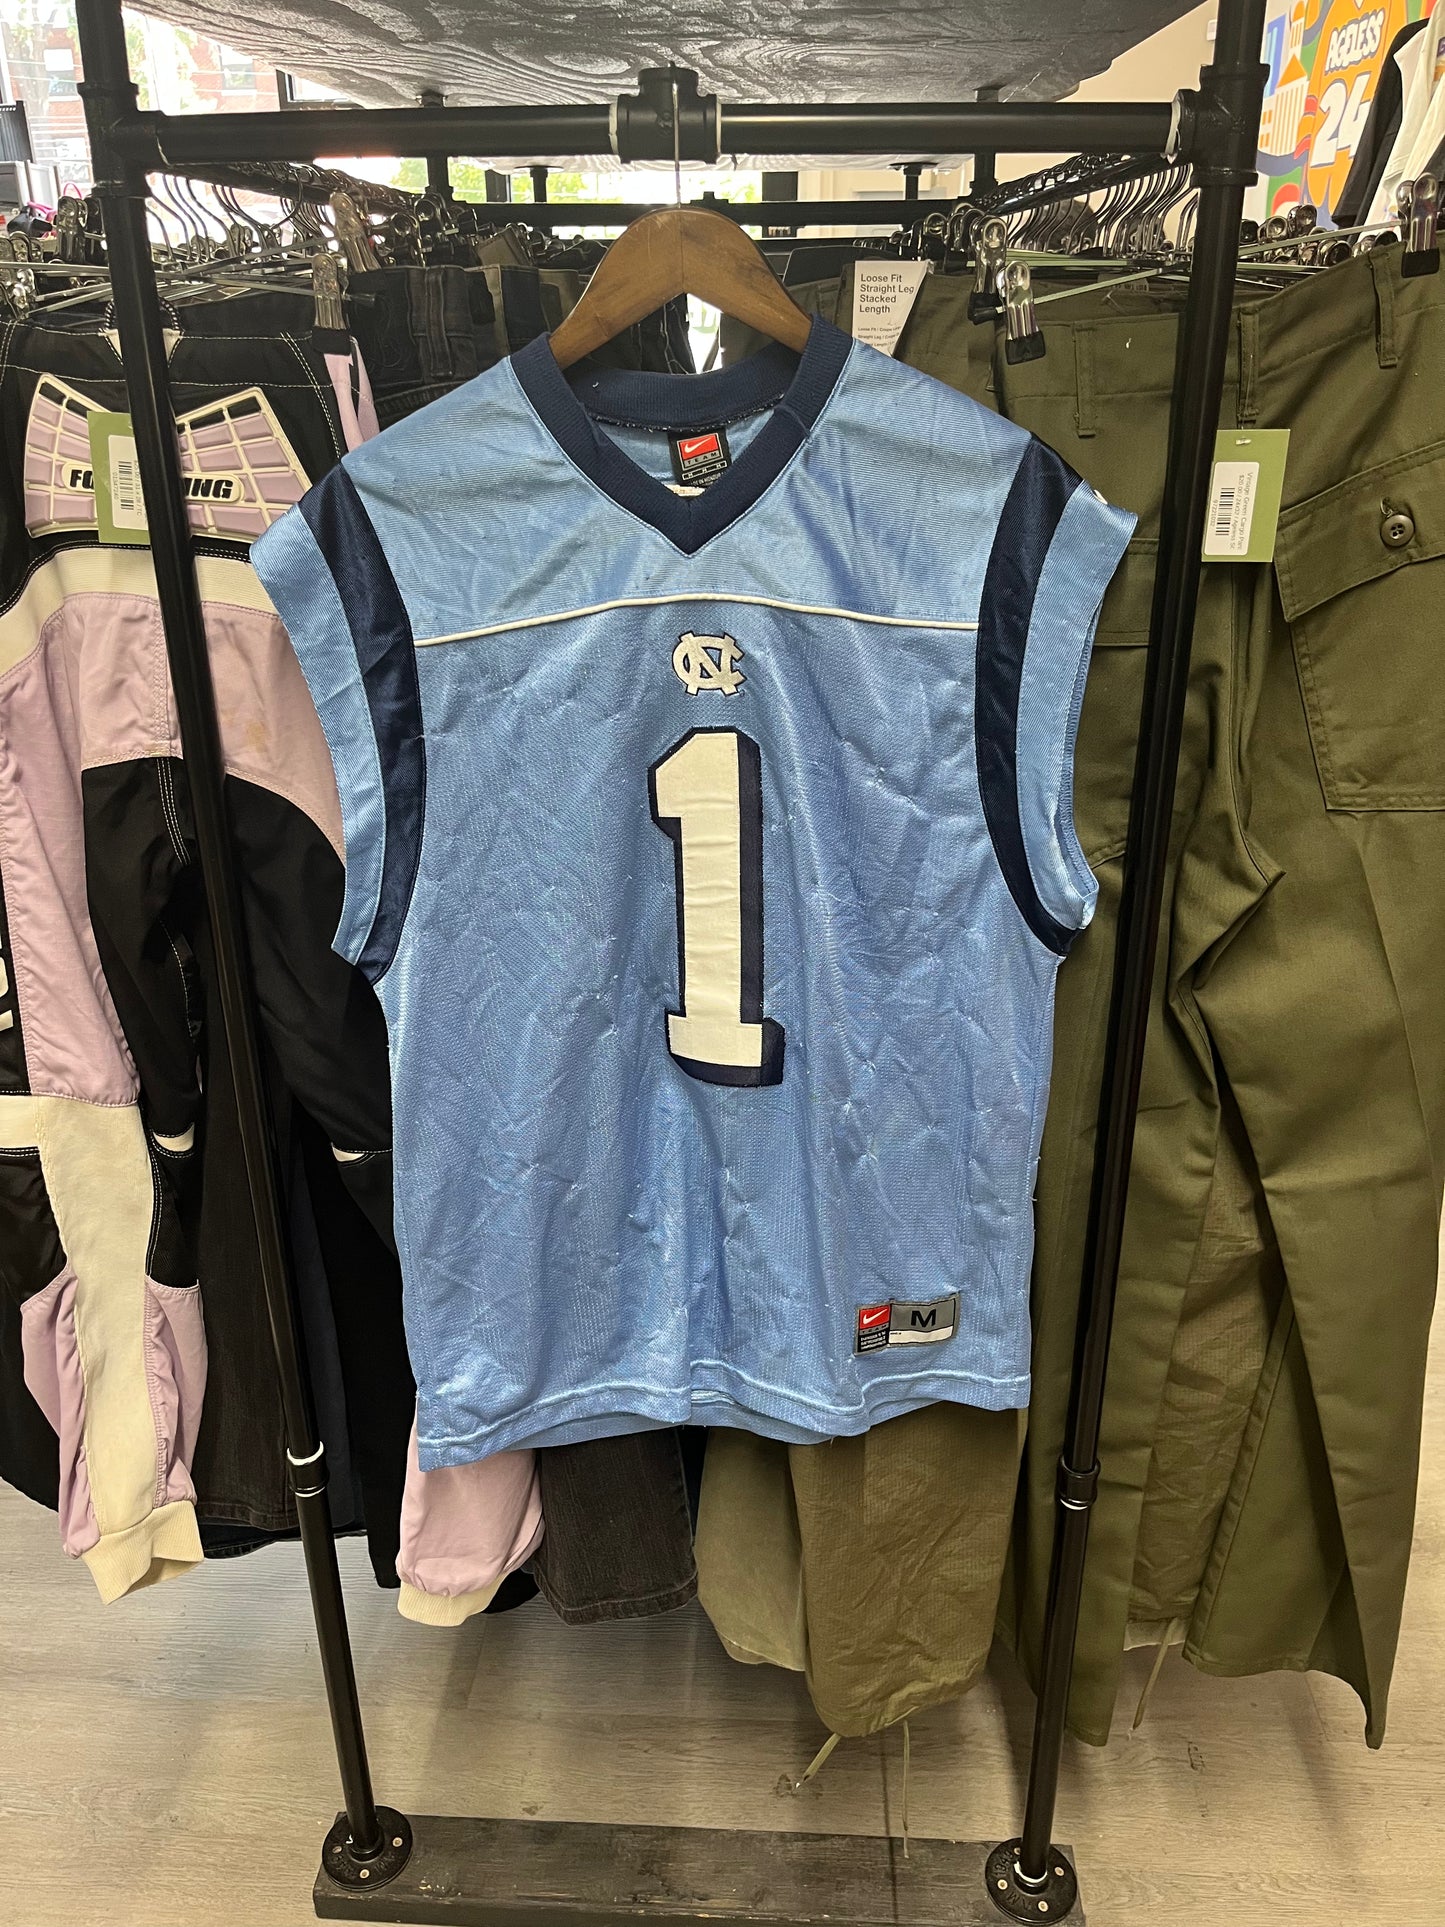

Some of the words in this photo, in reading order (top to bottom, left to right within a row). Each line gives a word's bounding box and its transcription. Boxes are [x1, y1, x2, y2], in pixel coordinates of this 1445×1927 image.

[1325, 10, 1385, 74] AGELESS
[1311, 73, 1373, 168] 24
[860, 274, 888, 282] Loose
[890, 274, 902, 282] Fit
[859, 294, 897, 303] Stacked
[860, 284, 896, 294] Straight
[898, 285, 915, 294] Leg
[859, 305, 891, 315] Length
[687, 452, 717, 465] TEAM
[1243, 472, 1254, 495] Vintage
[1241, 497, 1250, 516] Green
[1238, 517, 1247, 536] Cargo
[648, 726, 785, 1087] 1
[910, 1308, 937, 1328] M
